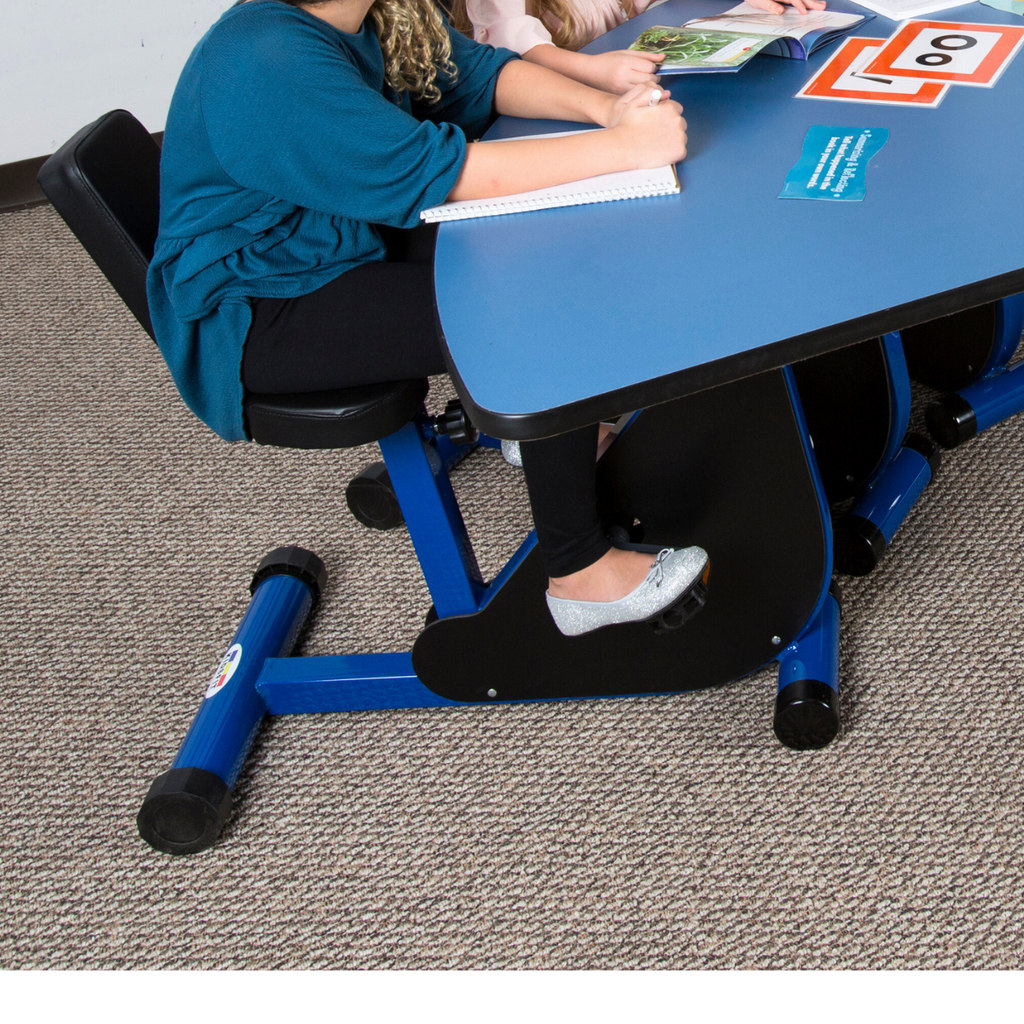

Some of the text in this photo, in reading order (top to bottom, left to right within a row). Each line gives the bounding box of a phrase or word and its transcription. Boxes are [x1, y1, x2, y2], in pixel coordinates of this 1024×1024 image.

[827, 137, 840, 148] book
[845, 134, 872, 161] Summarizing
[837, 144, 848, 154] what
[820, 153, 830, 163] your
[814, 164, 824, 172] own
[826, 154, 845, 176] happened
[806, 174, 820, 188] words.
[830, 168, 856, 192] Reflecting
[820, 182, 830, 190] the
